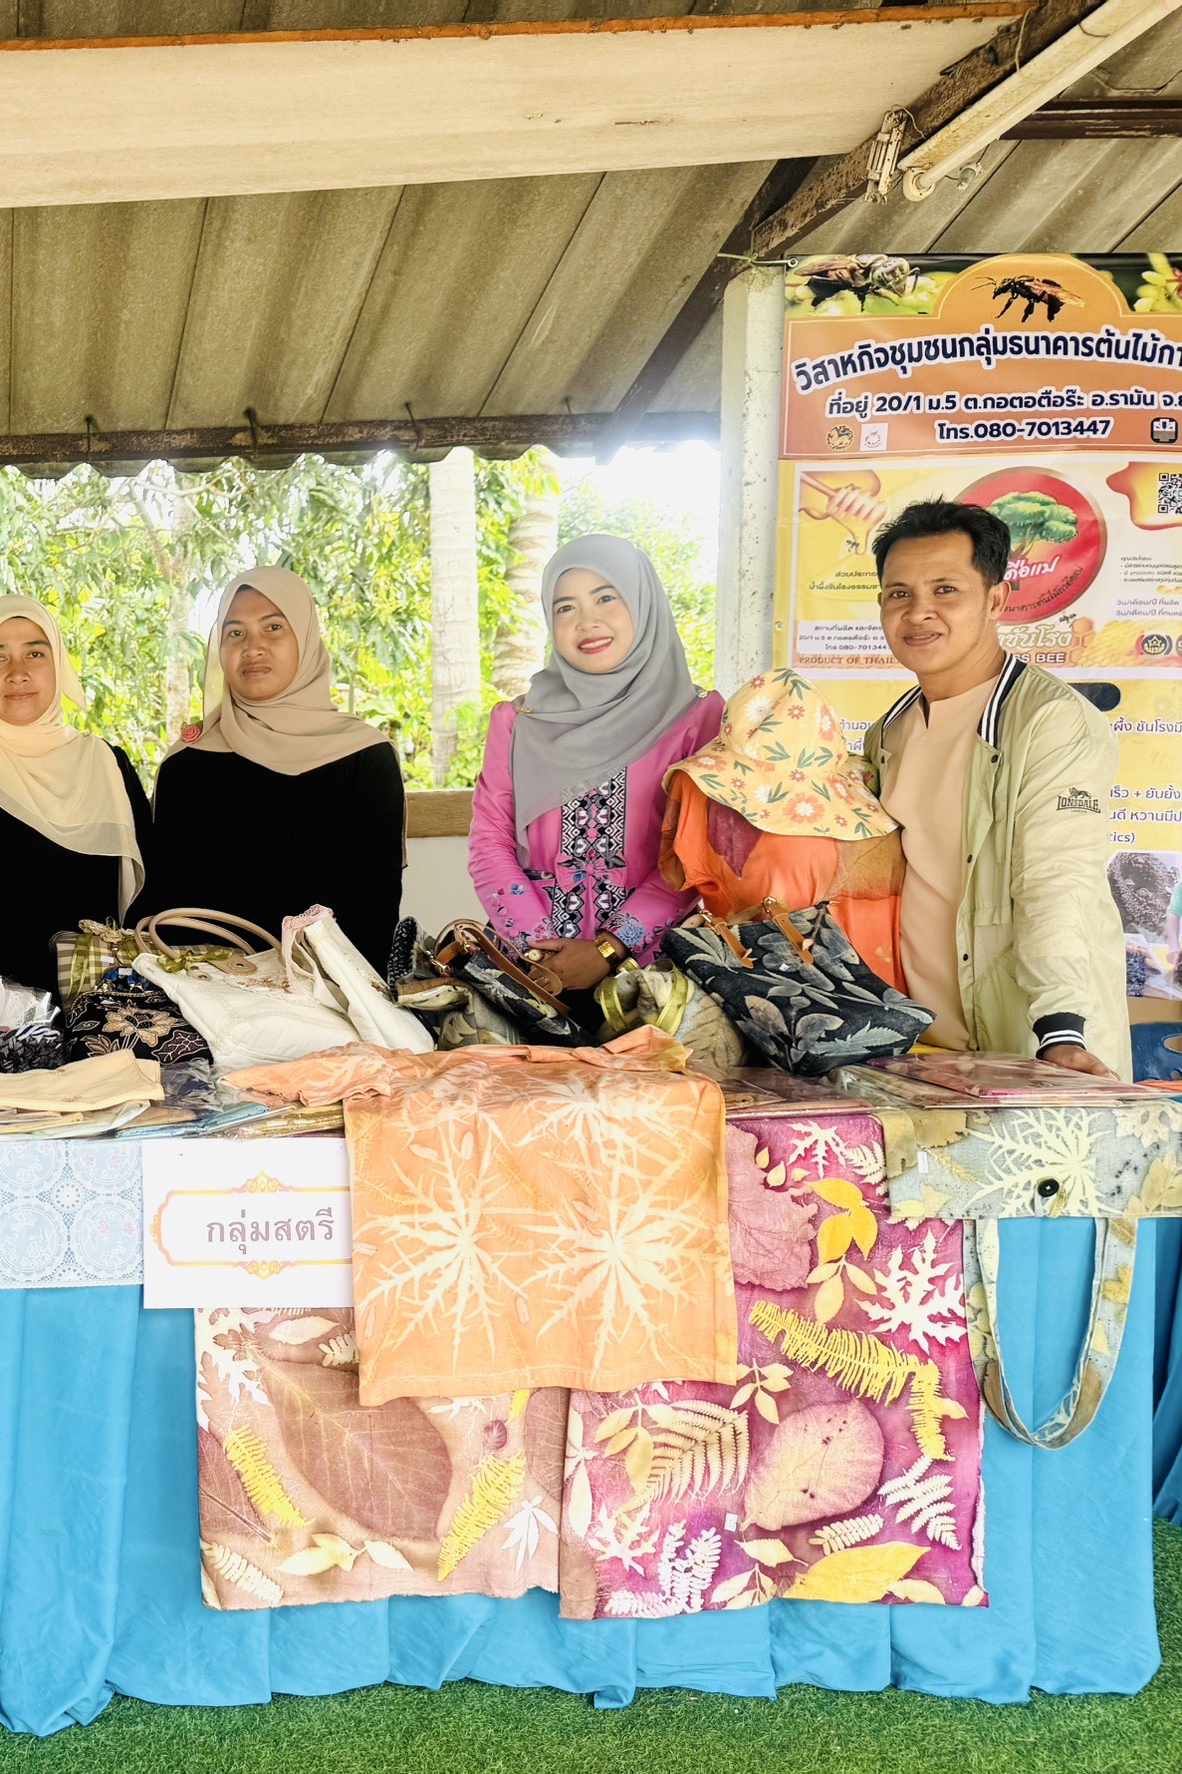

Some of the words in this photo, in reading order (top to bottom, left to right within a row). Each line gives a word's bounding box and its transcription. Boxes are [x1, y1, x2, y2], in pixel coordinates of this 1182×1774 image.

[828, 391, 868, 419] ที่อยู่
[875, 395, 921, 413] 20/1
[928, 394, 957, 410] ม.5
[1091, 388, 1155, 407] อ.รามัน
[938, 419, 1111, 440] โทร.080-7013447
[1036, 651, 1065, 663] BEE
[1109, 716, 1132, 732] ผึ้ง
[1057, 796, 1100, 811] LONSDALE
[205, 1206, 335, 1255] กลุ่มสตรี
